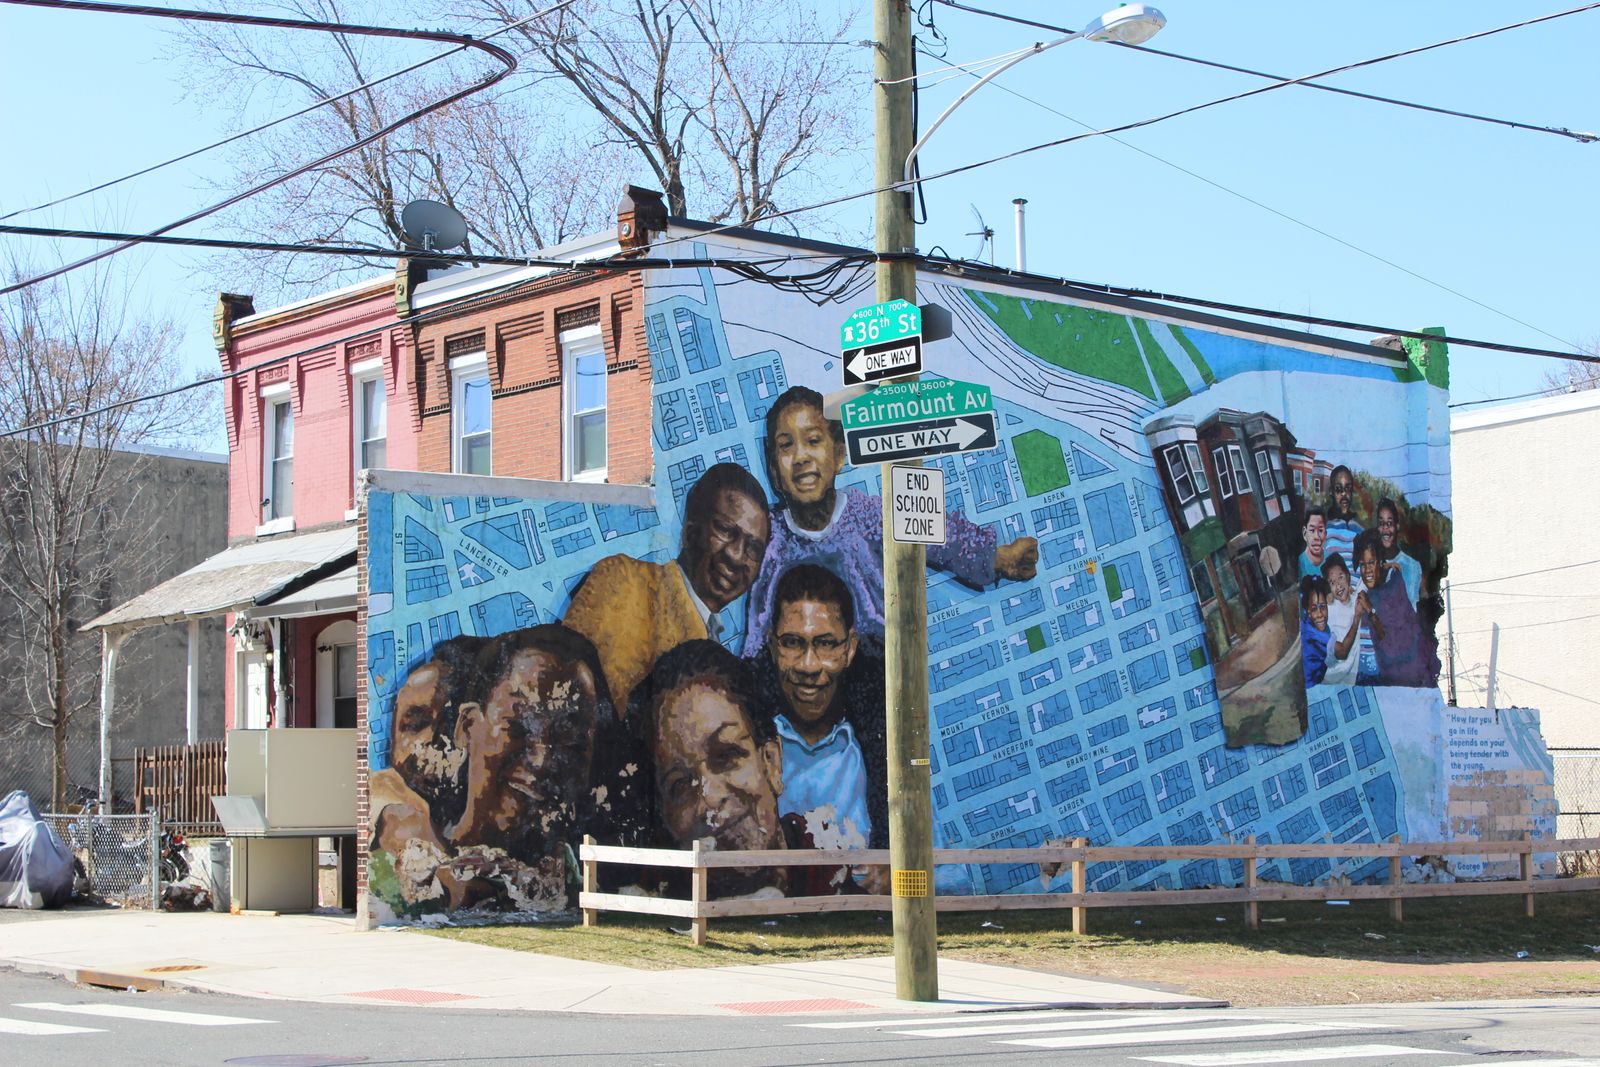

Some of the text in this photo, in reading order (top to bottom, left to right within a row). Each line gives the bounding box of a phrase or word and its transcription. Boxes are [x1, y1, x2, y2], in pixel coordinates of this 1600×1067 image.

[858, 302, 902, 318] 600 N 700
[898, 314, 917, 333] St
[865, 349, 912, 371] ONE WAY
[772, 358, 785, 388] UNION
[883, 379, 946, 396] 3500 W 3600
[687, 388, 705, 434] PRESTON
[845, 391, 987, 425] Fairmount Av
[867, 429, 952, 453] ONE WAY
[1009, 457, 1021, 483] 37TH
[906, 472, 929, 492] END
[896, 495, 941, 514] SCHOOL
[1043, 491, 1066, 505] ASPEN
[1127, 494, 1139, 518] 35TH
[537, 521, 547, 534] ST
[904, 517, 934, 537] ZONE
[395, 532, 403, 546] ST
[459, 538, 509, 578] LANCASTER
[1067, 553, 1106, 573] FAIRMOUNT
[1065, 598, 1090, 611] MELON
[932, 607, 961, 624] AVENUE
[1050, 619, 1061, 643] 37TH
[397, 638, 405, 666] 44TH
[940, 704, 1011, 738] MOUNT VERNON
[1479, 716, 1493, 726] you
[1467, 727, 1479, 736] life
[991, 738, 1034, 761] HAVERFORD
[1309, 734, 1340, 752] HAMILTON
[1449, 738, 1479, 748] depends
[1490, 740, 1505, 749] your
[1065, 745, 1109, 769] BRANDYWINE
[1450, 751, 1469, 760] being
[1470, 750, 1493, 758] tender
[1451, 762, 1462, 770] the
[991, 797, 1185, 842] SPRING GARDEN ST
[1456, 861, 1480, 871] George
